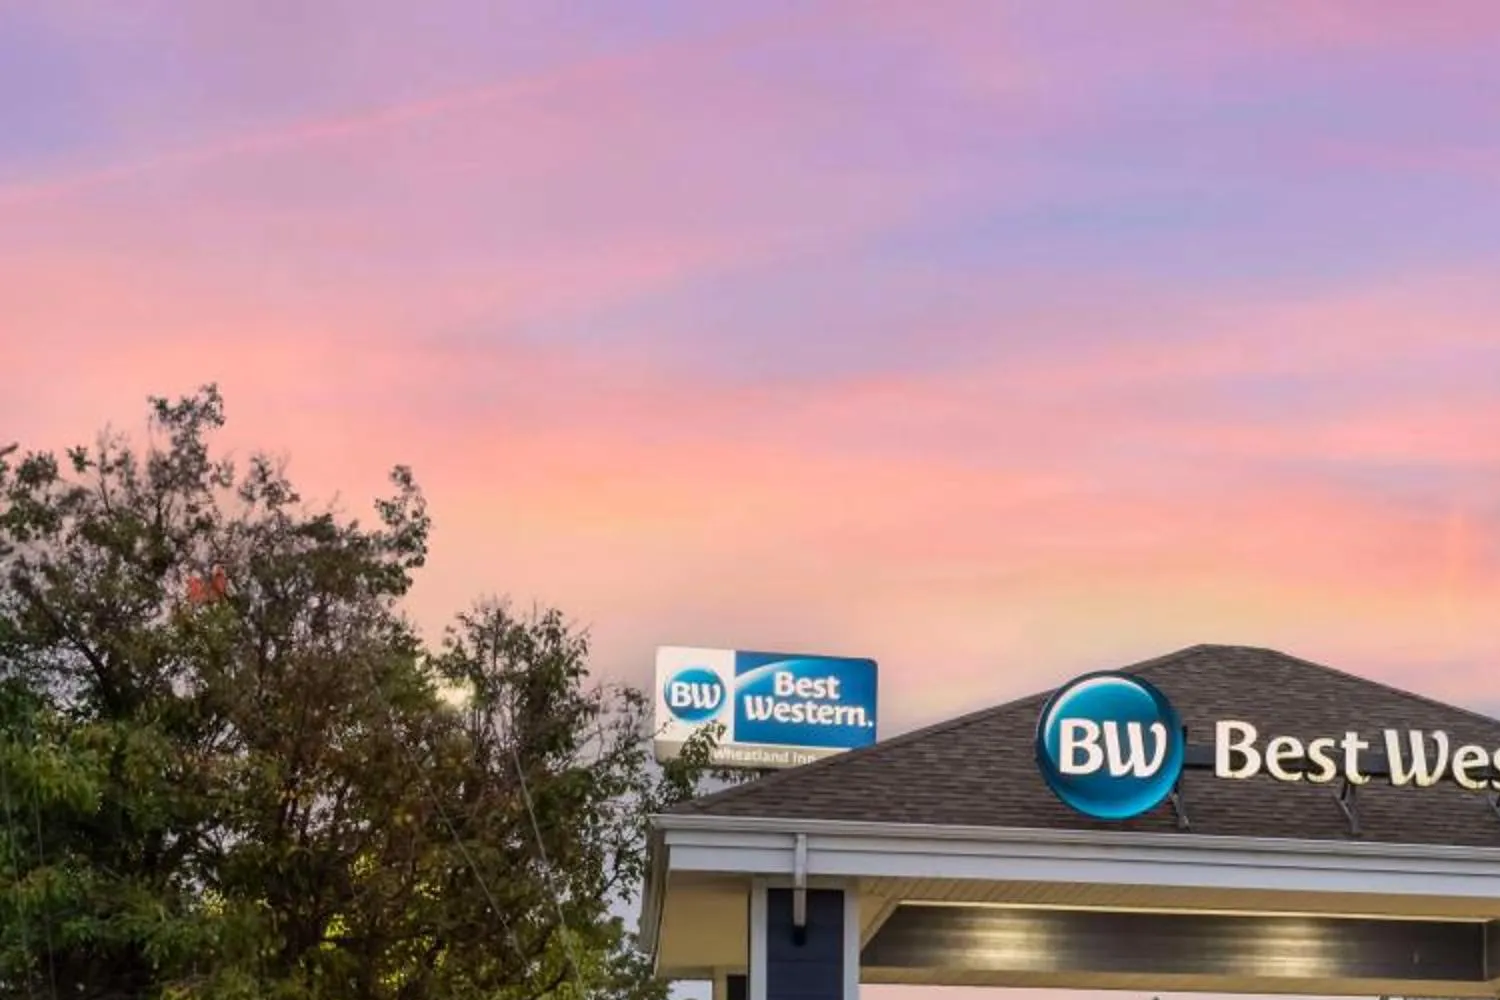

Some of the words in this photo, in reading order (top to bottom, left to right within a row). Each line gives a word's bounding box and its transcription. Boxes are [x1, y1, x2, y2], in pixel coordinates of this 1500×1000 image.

[671, 682, 721, 709] BW
[774, 671, 841, 699] Best
[1058, 718, 1167, 776] BW
[1215, 720, 1369, 784] Best
